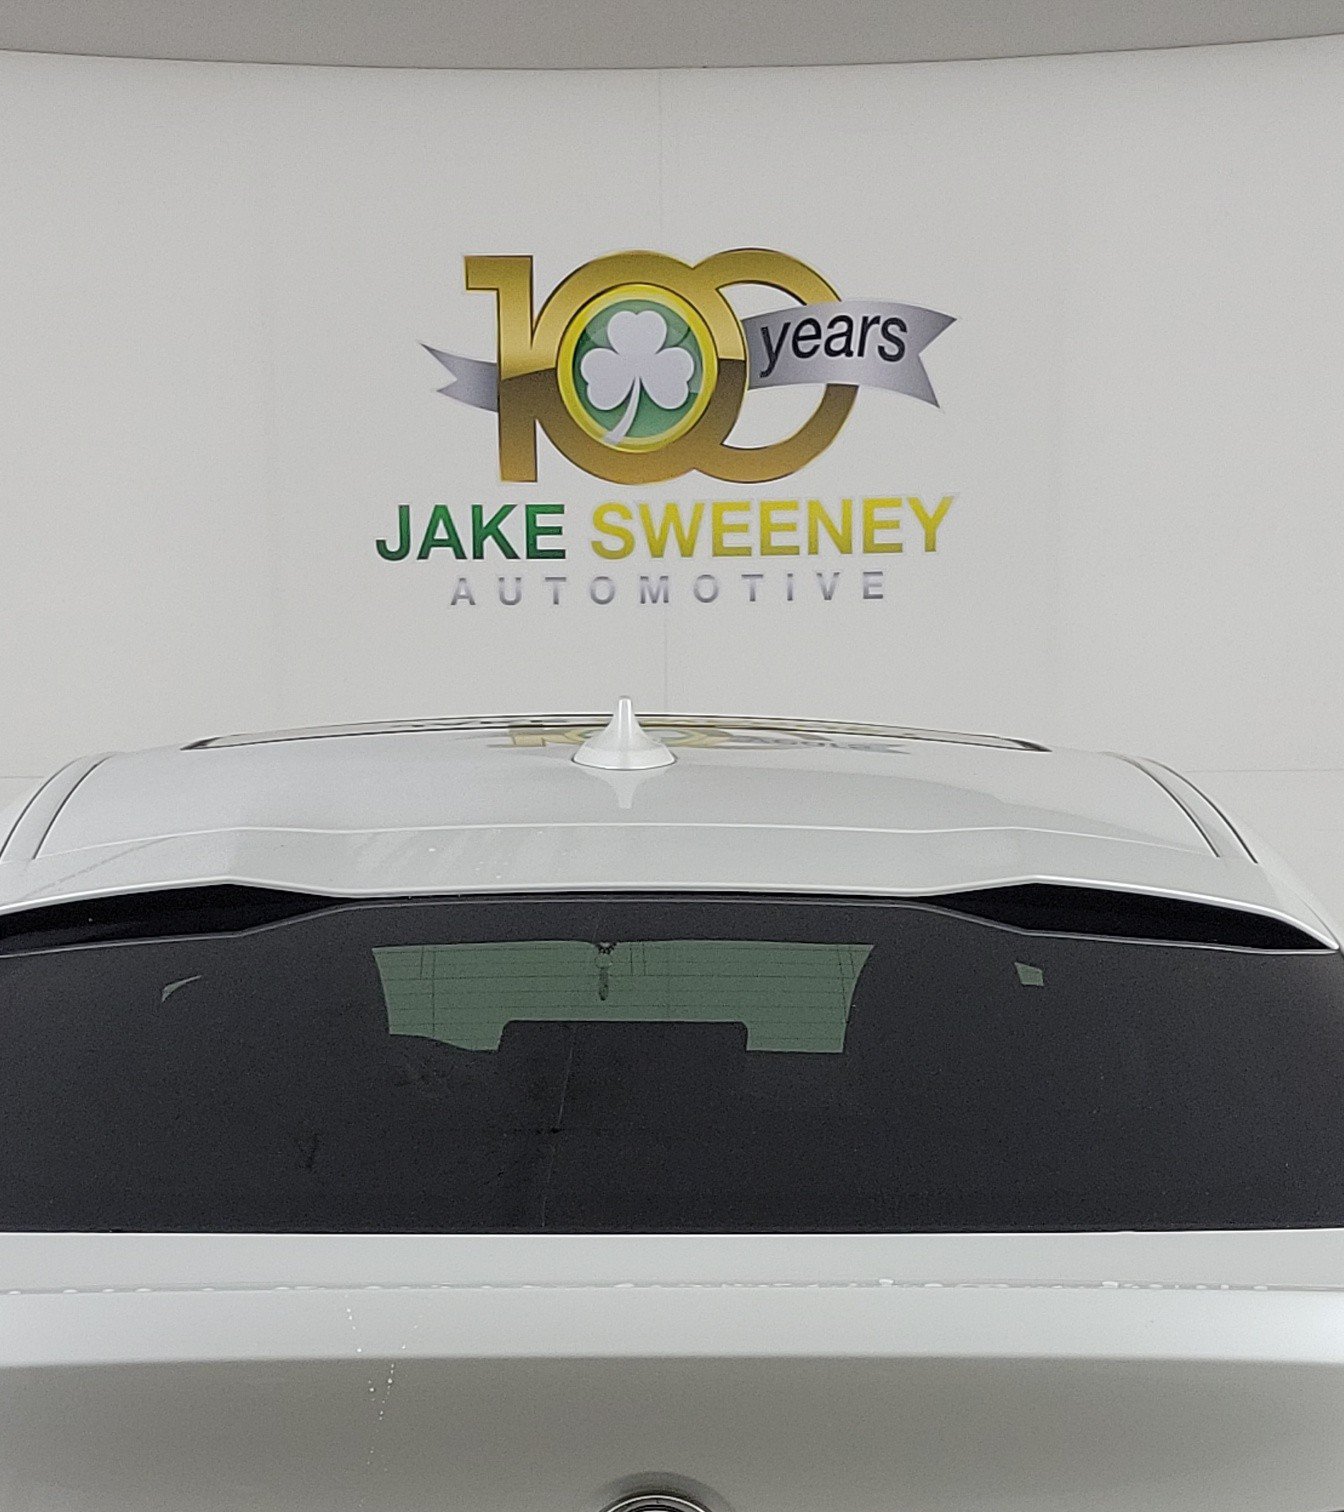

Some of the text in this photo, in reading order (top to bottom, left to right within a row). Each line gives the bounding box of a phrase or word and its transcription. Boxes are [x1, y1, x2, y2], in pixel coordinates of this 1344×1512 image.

[463, 247, 909, 485] 100 years
[375, 495, 955, 562] JAKE SWEENEY
[449, 570, 887, 606] AUTOMOTIVE
